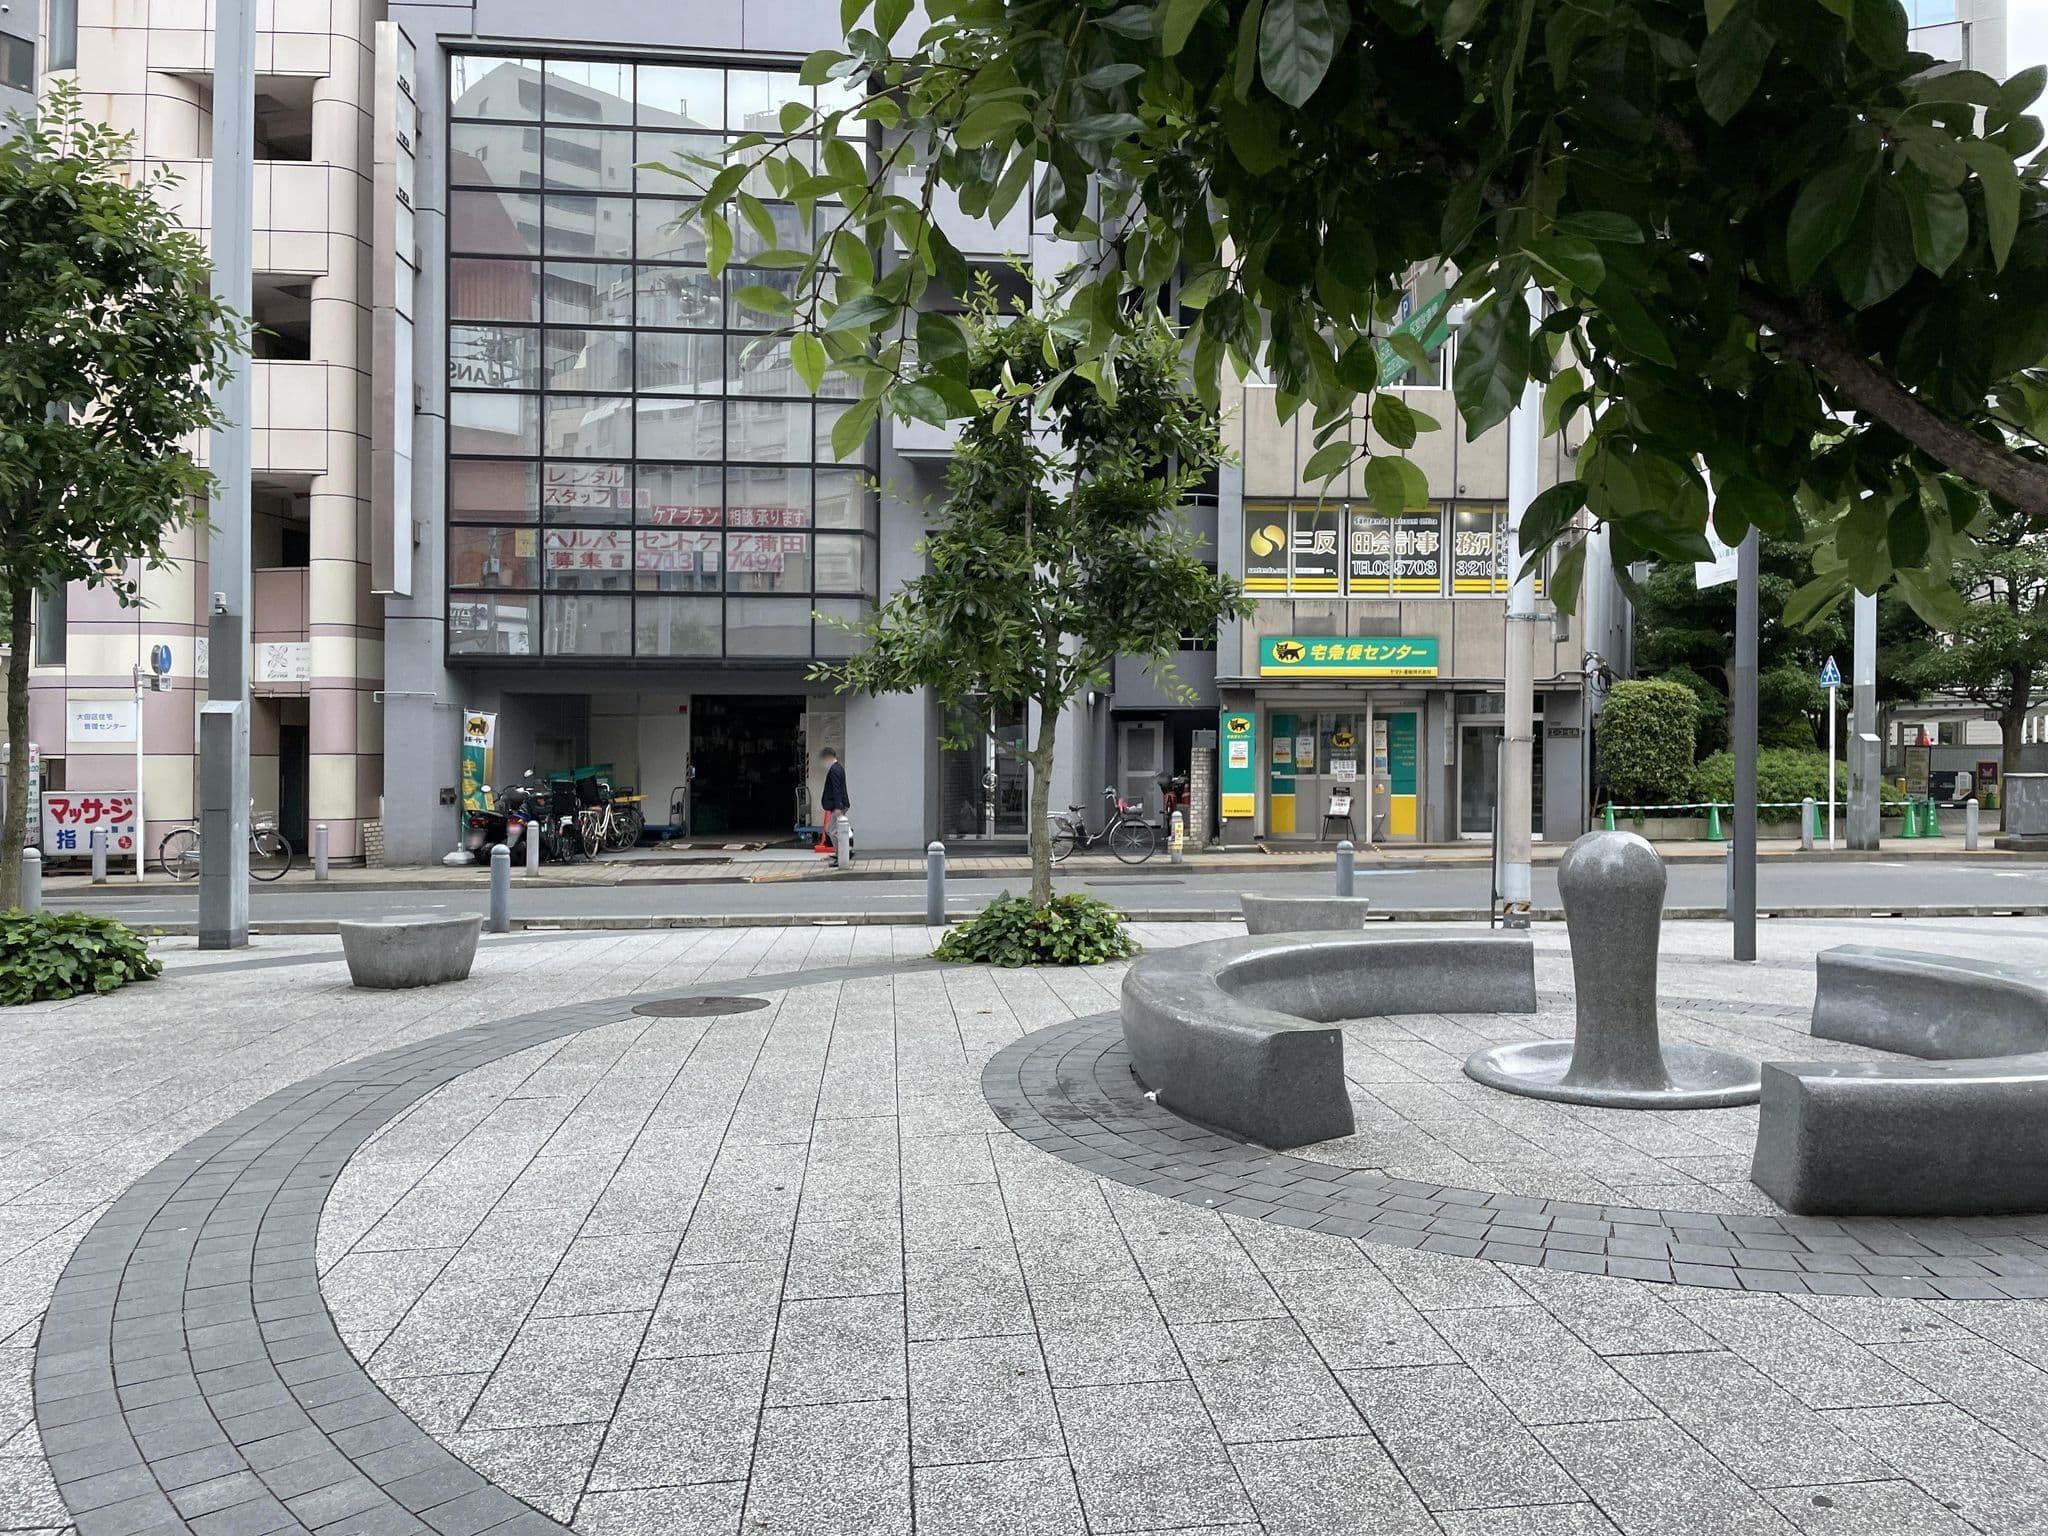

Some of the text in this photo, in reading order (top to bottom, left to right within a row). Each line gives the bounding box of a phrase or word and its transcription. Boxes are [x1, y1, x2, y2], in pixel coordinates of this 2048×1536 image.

[545, 488, 610, 504] スタッフ
[729, 509, 804, 527] 相談承ります
[545, 531, 804, 552] ヘルパー セントケア蒲田
[551, 552, 602, 569] 募集
[1311, 644, 1427, 660] 宅急便センター
[48, 799, 133, 824] マッサージ
